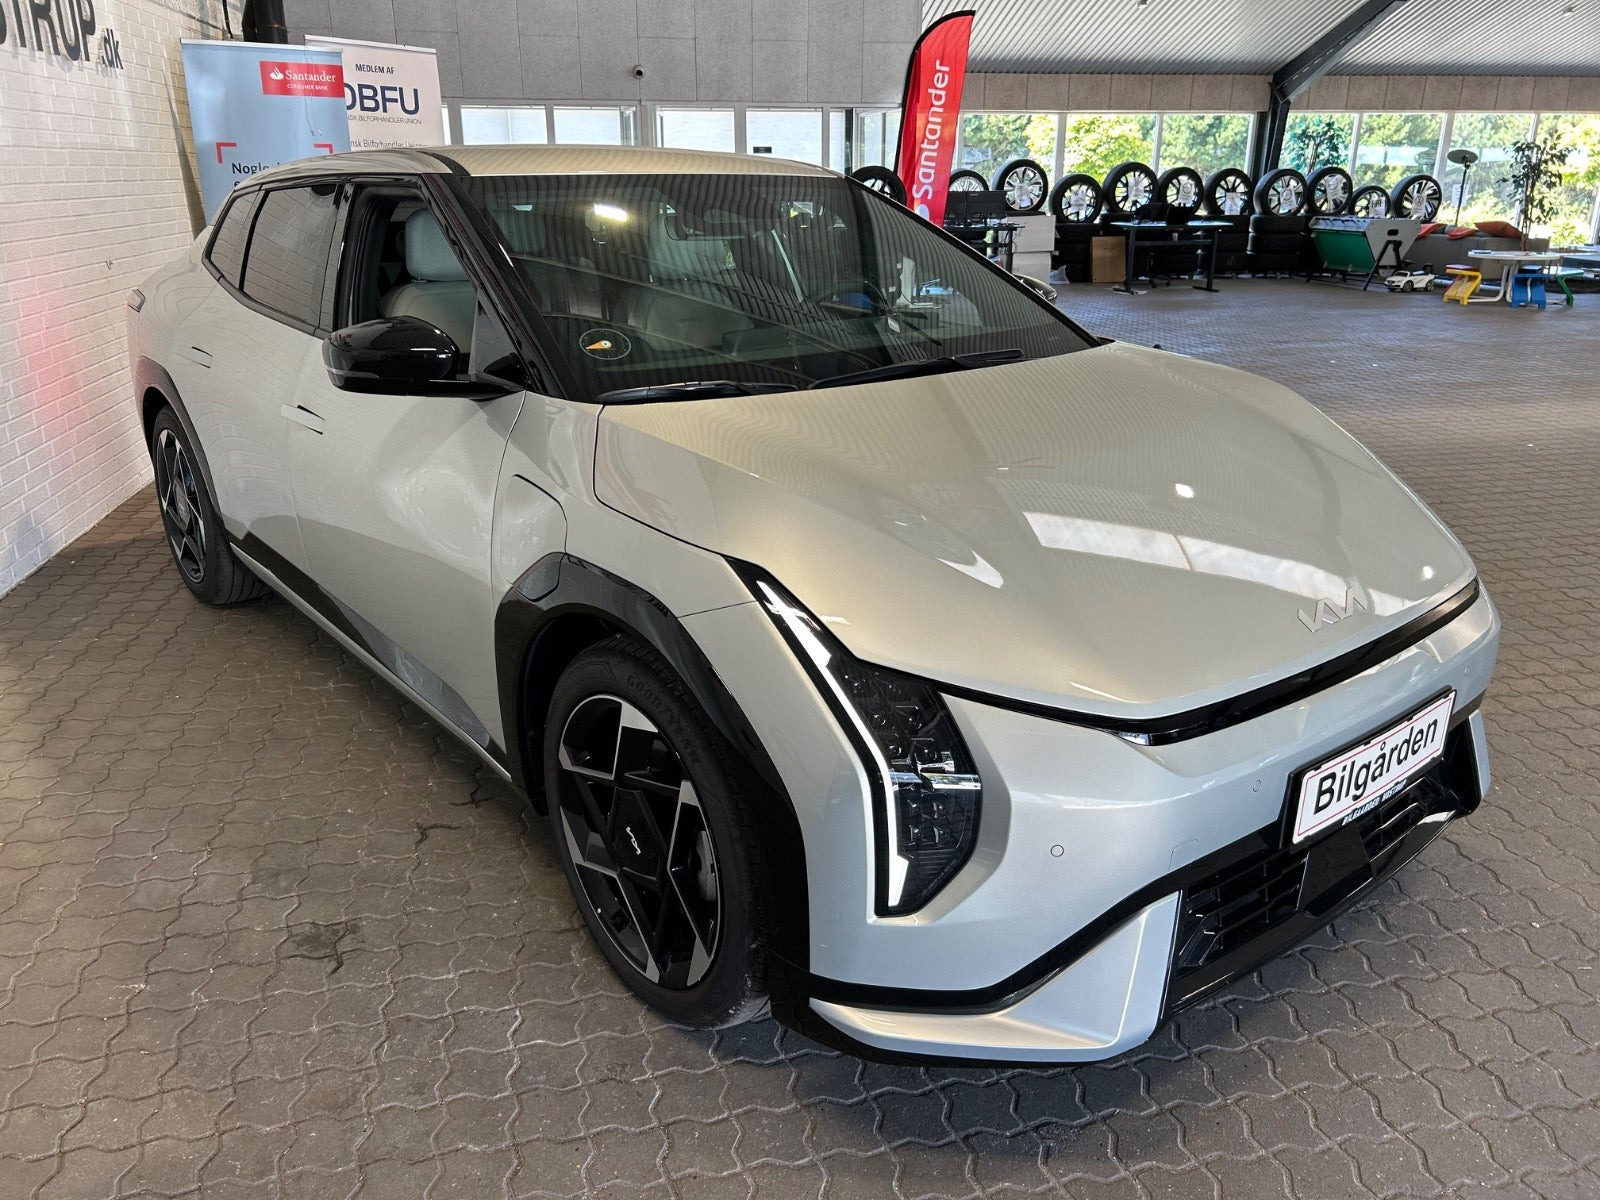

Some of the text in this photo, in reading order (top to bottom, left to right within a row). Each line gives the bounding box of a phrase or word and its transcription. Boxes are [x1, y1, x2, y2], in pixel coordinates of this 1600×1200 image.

[285, 69, 336, 82] Santander
[355, 64, 395, 75] MEDLEM AF
[912, 60, 950, 200] Santander
[1313, 718, 1438, 815] Bilgården
